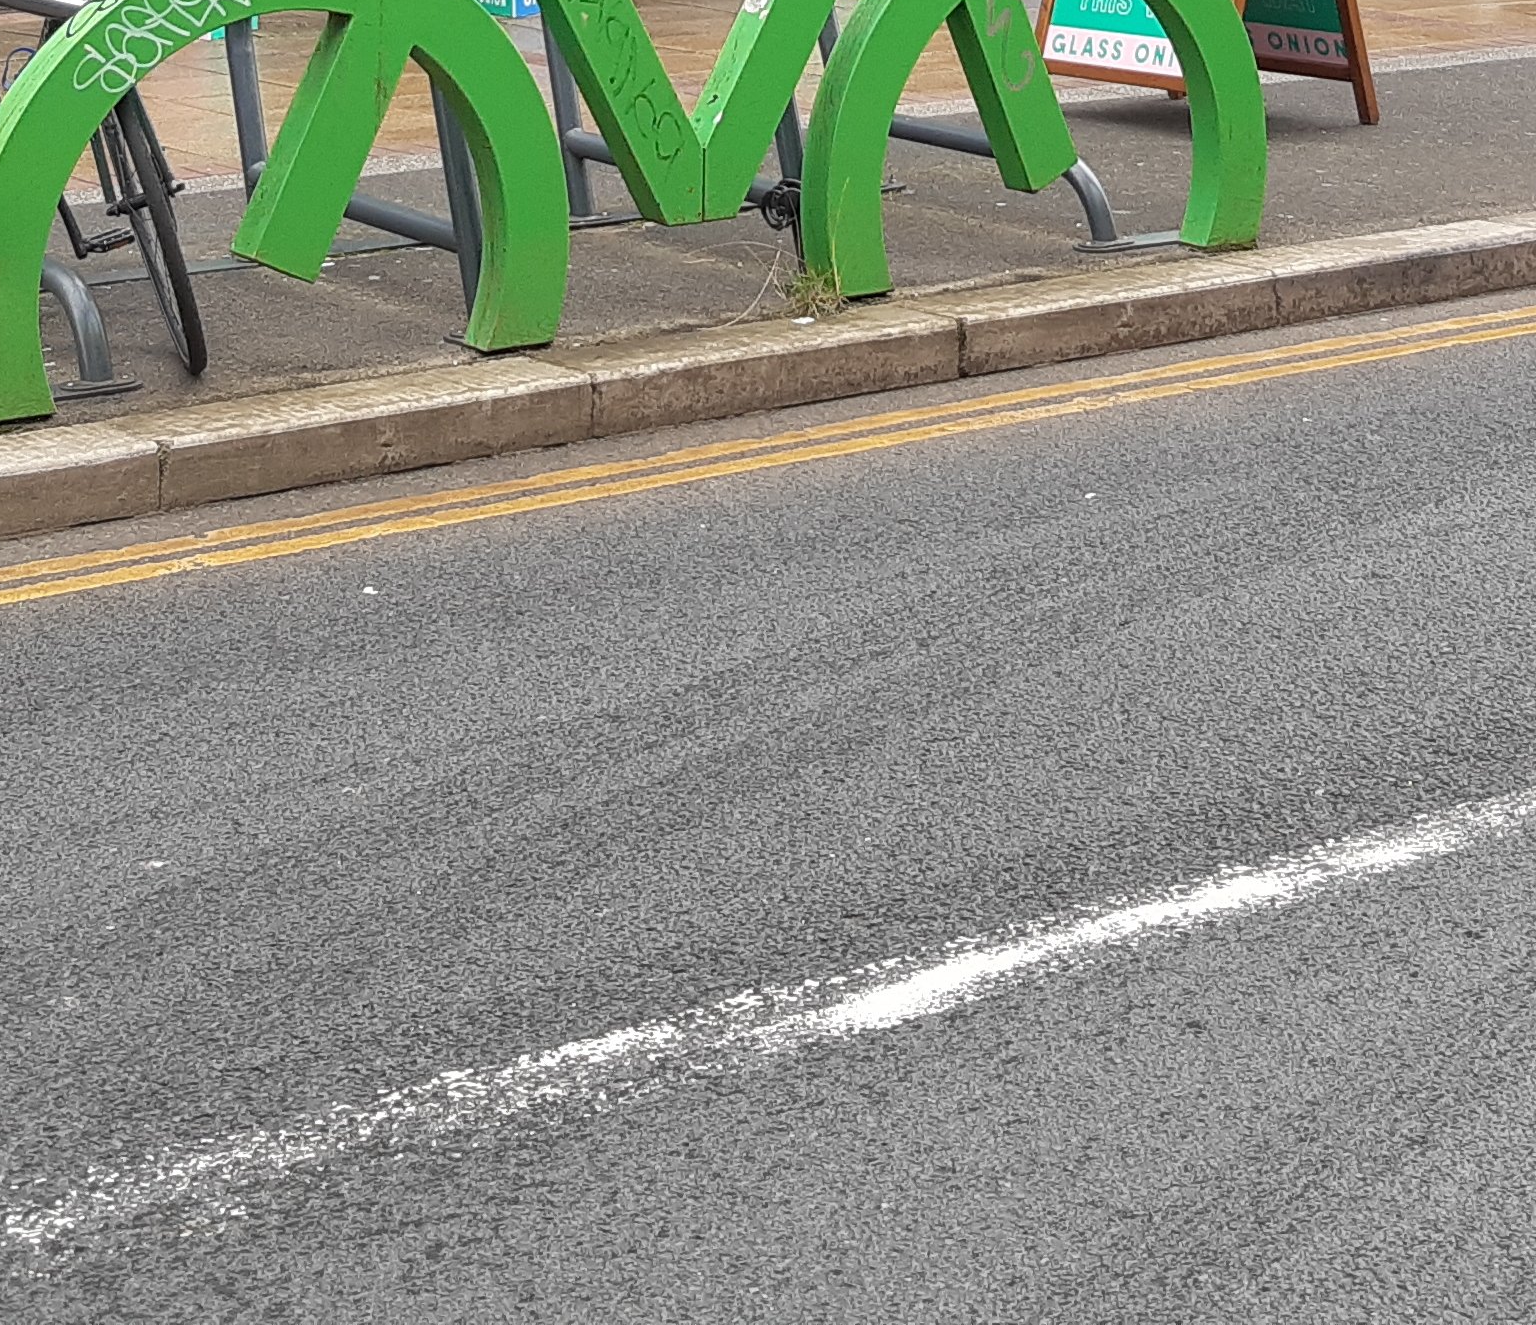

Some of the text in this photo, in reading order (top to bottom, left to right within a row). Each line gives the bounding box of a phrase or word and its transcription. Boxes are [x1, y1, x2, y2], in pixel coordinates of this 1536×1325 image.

[1052, 33, 1174, 68] GLASS ONI
[1268, 31, 1349, 58] ONION
